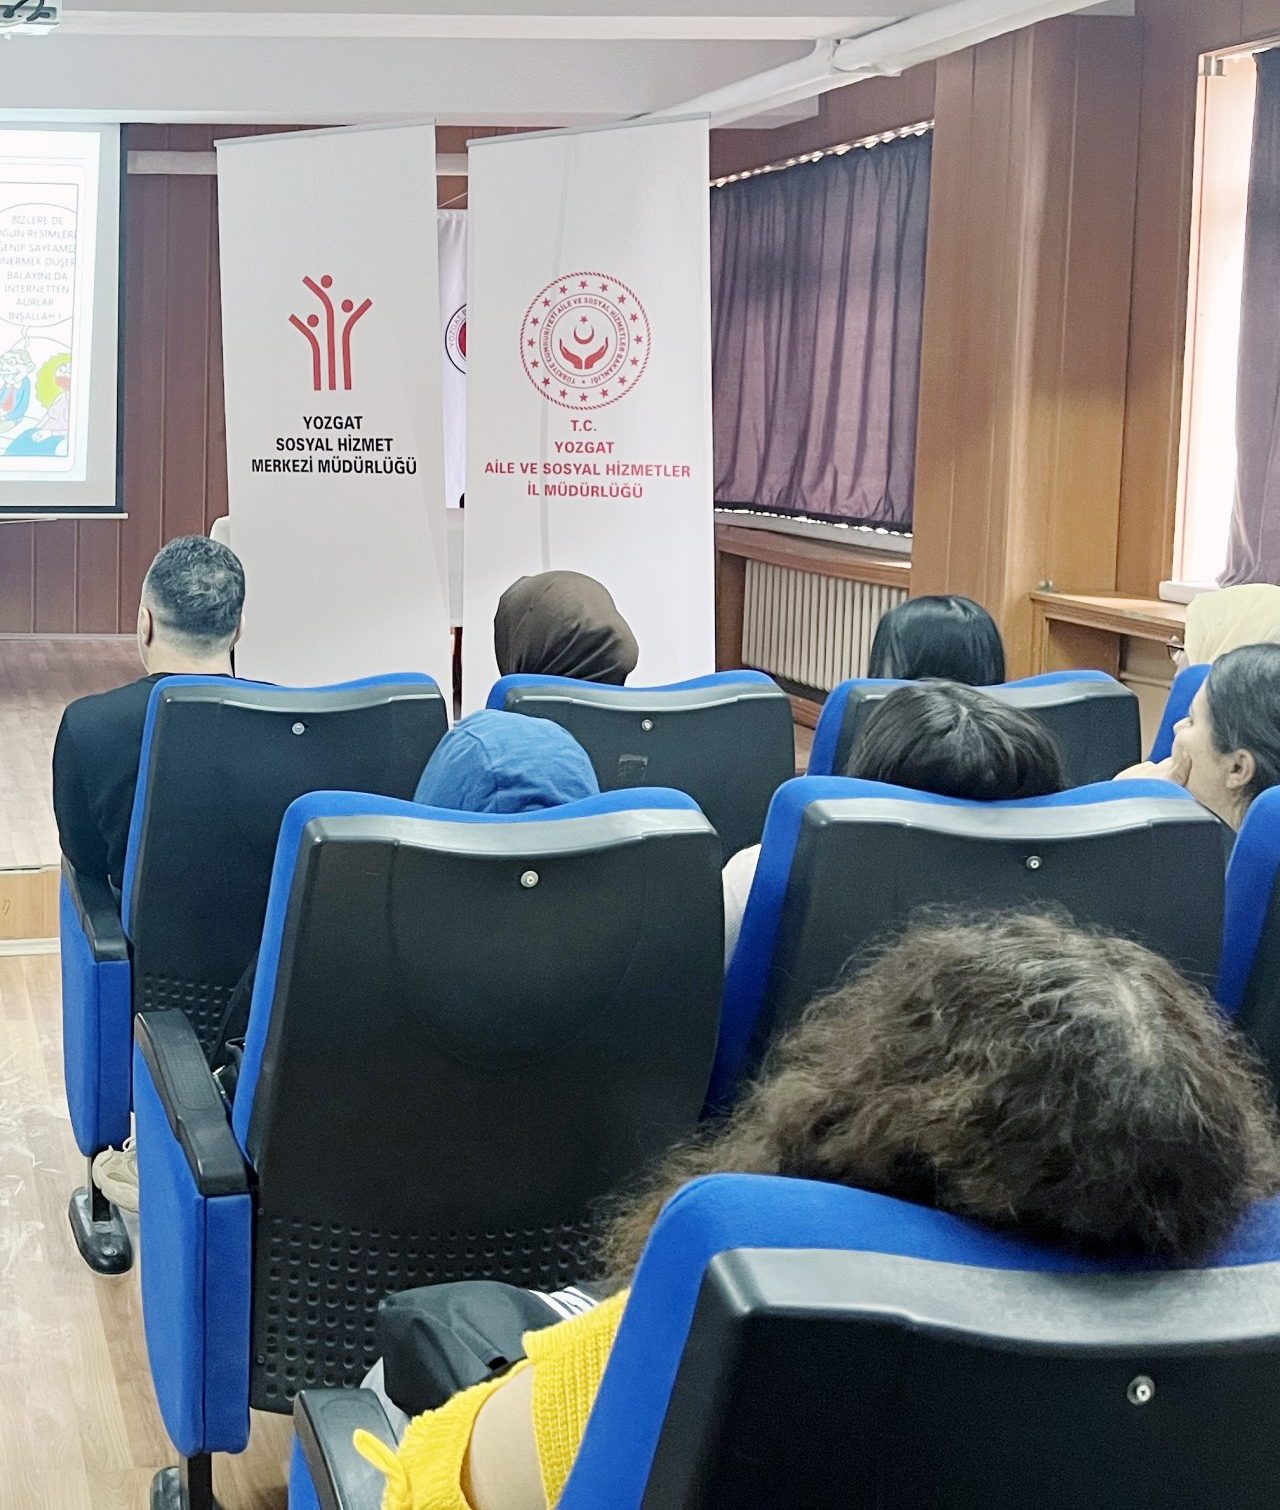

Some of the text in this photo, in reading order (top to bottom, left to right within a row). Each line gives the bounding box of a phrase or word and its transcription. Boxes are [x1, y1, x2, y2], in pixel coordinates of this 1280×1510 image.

[557, 300, 572, 314] AİLE
[573, 297, 582, 305] VE
[584, 297, 610, 312] SOSYAL
[302, 415, 363, 430] YOZGAT
[570, 419, 597, 432] T.C.
[276, 435, 393, 452] SOSYAL HİZMET
[554, 440, 615, 454] YOZGAT
[251, 455, 417, 475] MERKEZİ MÜDÜRLÜĞÜ
[484, 459, 691, 478] AİLE VE SOSYAL HİZMETLER
[527, 479, 643, 499] İL MÜDÜRLÜĞÜ
